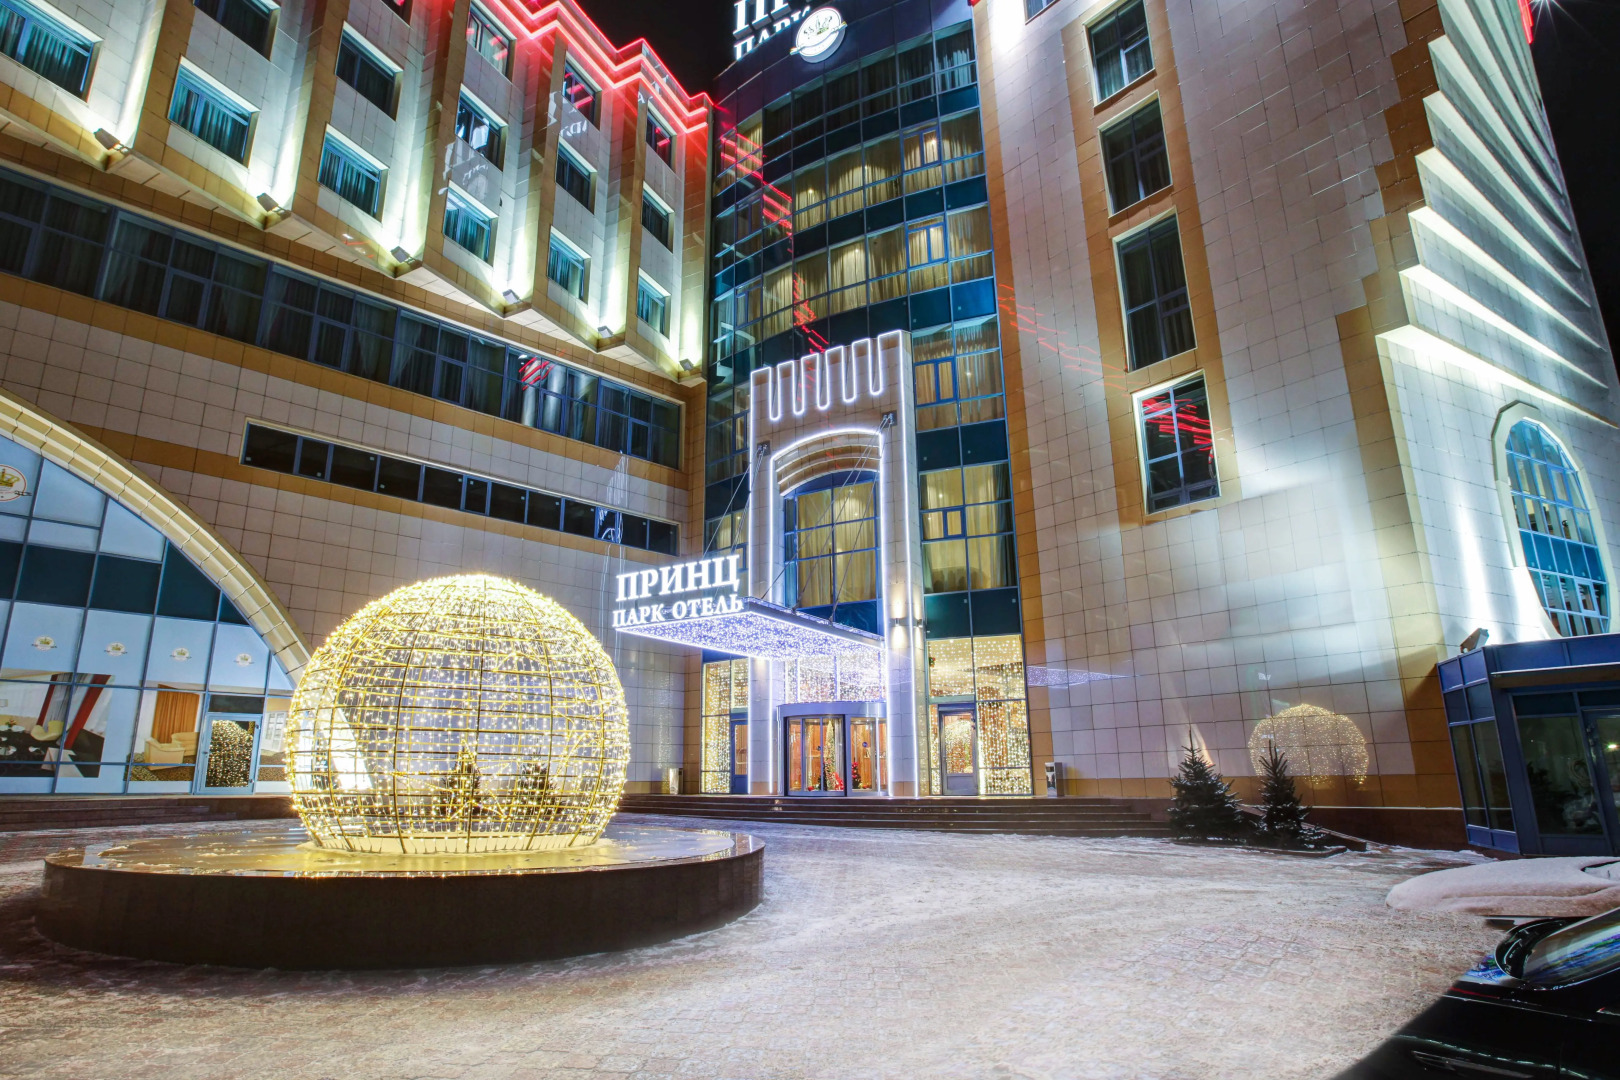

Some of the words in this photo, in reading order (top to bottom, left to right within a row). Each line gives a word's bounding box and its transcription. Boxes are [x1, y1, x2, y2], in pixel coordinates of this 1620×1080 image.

[615, 554, 740, 602] ПРИНЦ
[612, 603, 666, 628] ПАРК
[672, 593, 745, 620] ОТЕЛЬ
